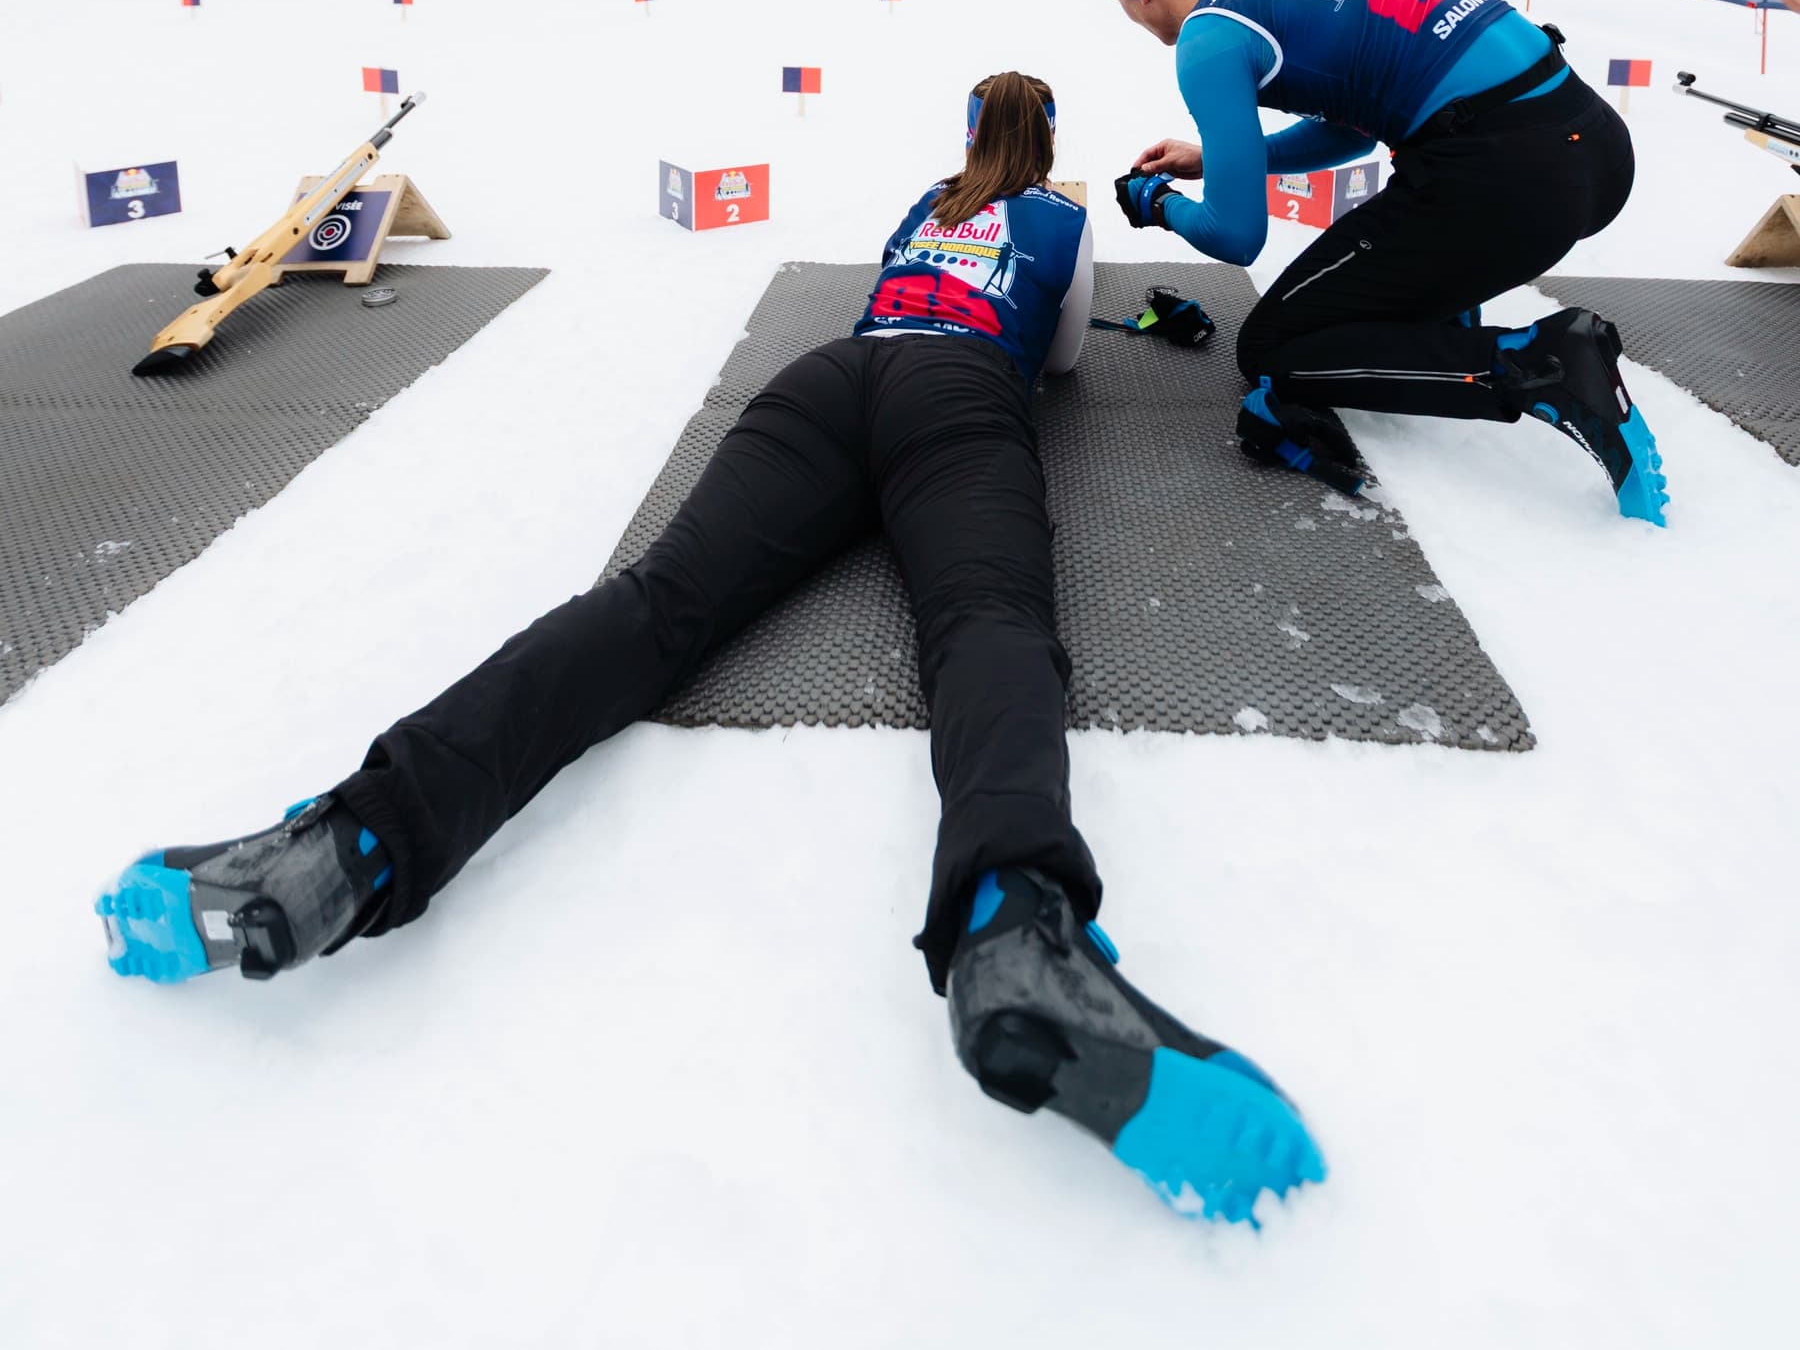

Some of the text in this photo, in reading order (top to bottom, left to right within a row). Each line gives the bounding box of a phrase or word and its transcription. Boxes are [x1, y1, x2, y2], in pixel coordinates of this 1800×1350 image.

[127, 199, 146, 219] 3
[671, 201, 680, 220] 3
[725, 203, 741, 223] 2
[1286, 199, 1300, 220] 2
[918, 222, 1001, 243] Red Bull
[871, 273, 1002, 338] 85
